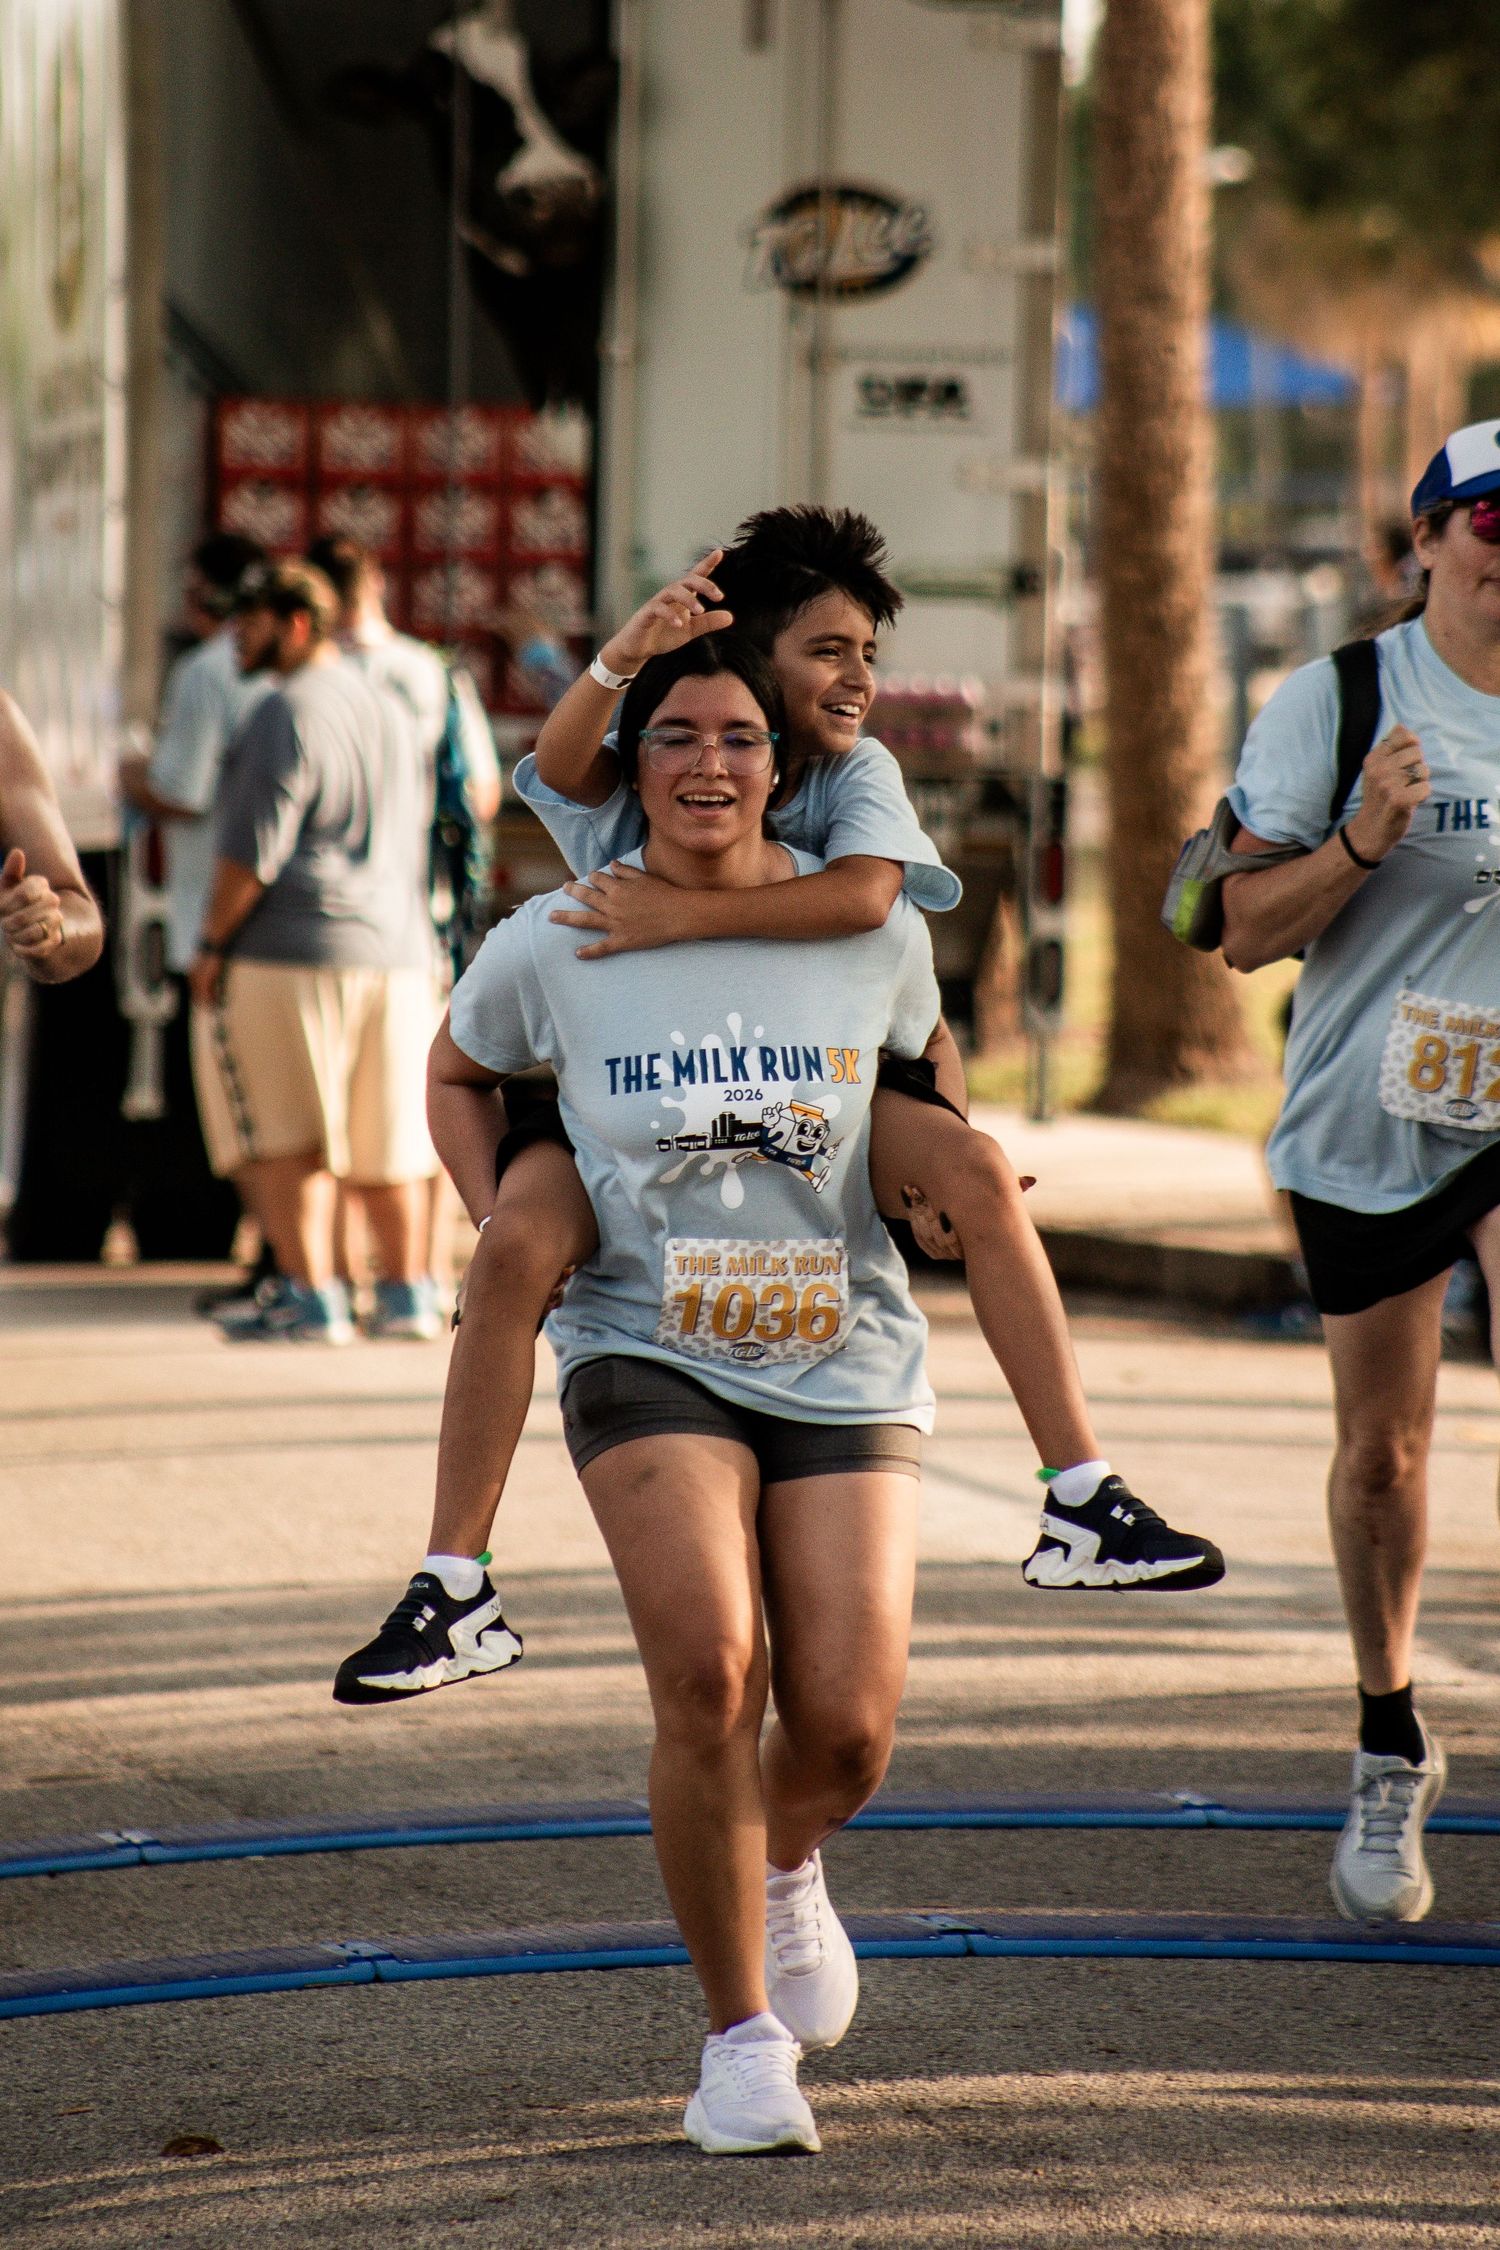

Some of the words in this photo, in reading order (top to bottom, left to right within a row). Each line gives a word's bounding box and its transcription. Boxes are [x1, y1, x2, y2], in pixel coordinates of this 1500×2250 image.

[1433, 799, 1490, 833] THE
[1402, 1004, 1439, 1030] THE
[605, 1052, 663, 1095] THE
[672, 1046, 751, 1087] MILK
[759, 1046, 824, 1082] RUN
[826, 1047, 862, 1084] 5K
[723, 1088, 764, 1102] 2026
[674, 1255, 721, 1276] THE
[725, 1255, 788, 1277] MILK
[794, 1255, 841, 1276] RUN
[674, 1283, 842, 1344] 1036
